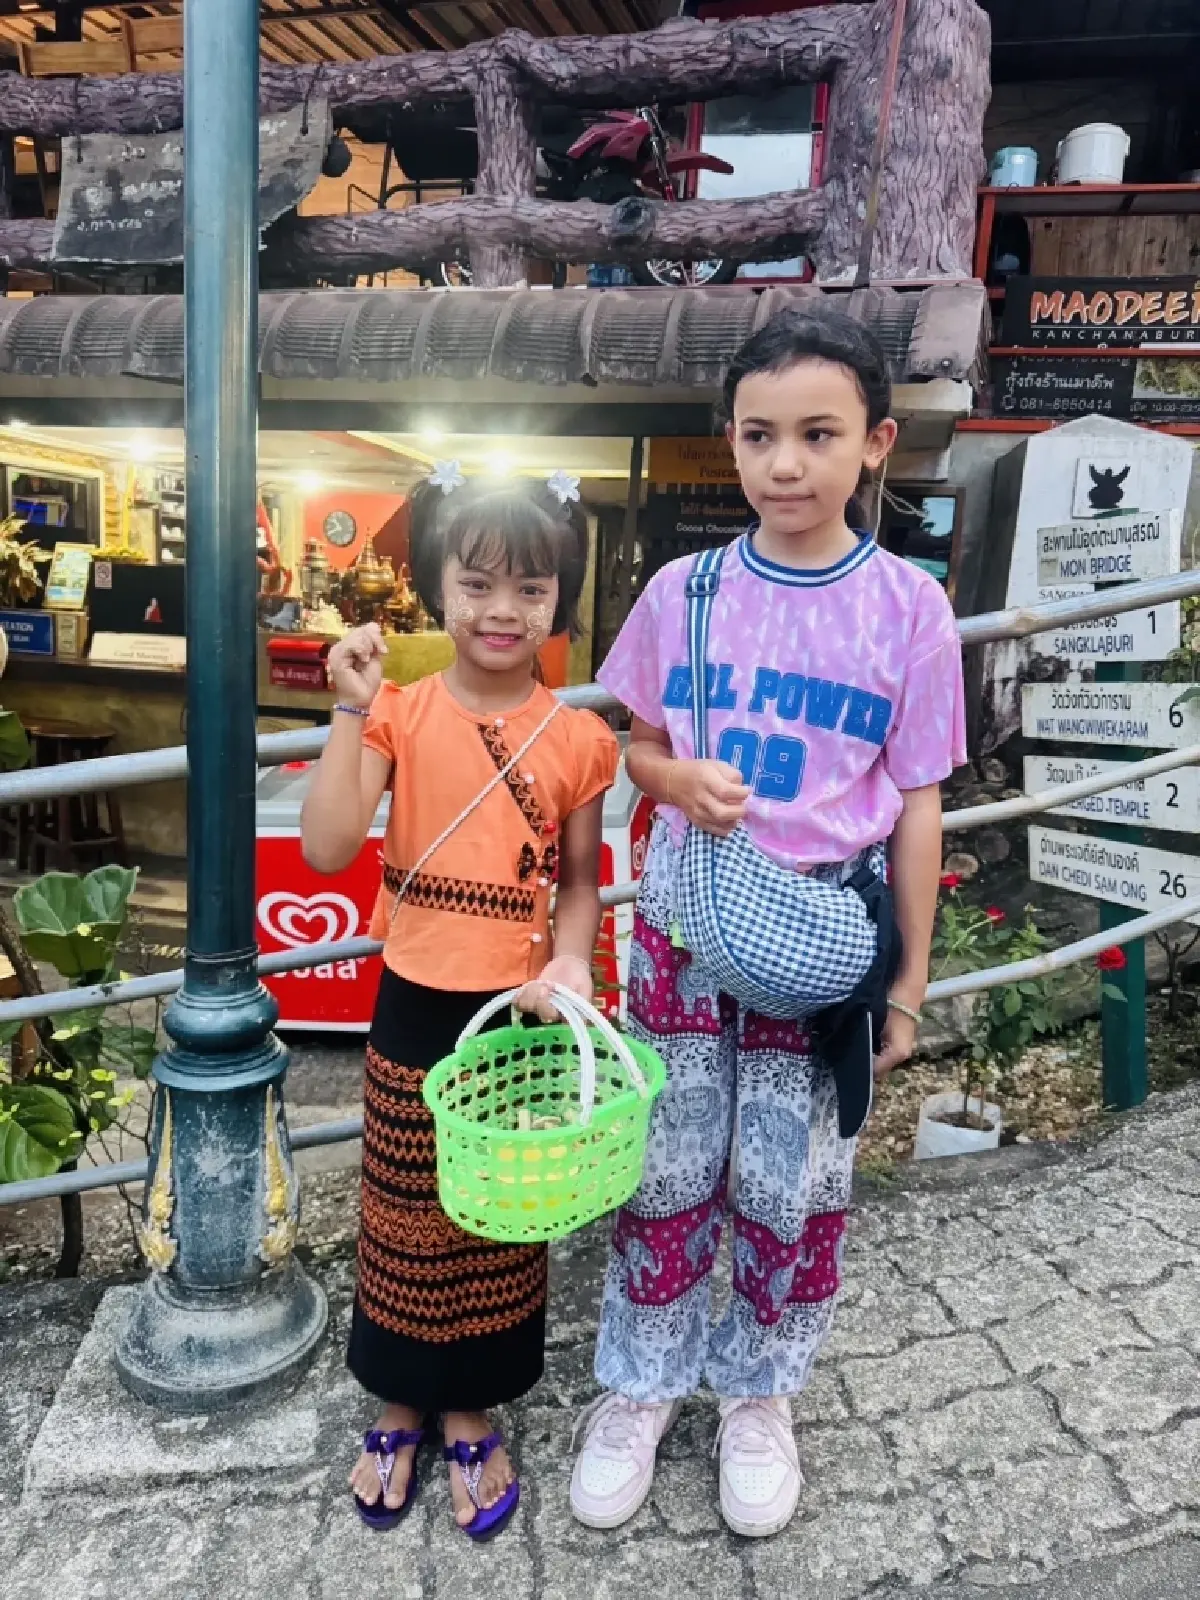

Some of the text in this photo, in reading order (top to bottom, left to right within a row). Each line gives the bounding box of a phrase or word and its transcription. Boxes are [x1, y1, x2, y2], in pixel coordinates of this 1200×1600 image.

[1060, 554, 1132, 578] MON BRIDGE
[1147, 610, 1156, 635] 1
[1054, 633, 1134, 654] SANGKLABURI
[662, 664, 893, 746] GL POWER
[1168, 702, 1184, 728] 6
[1036, 718, 1055, 734] WAT
[716, 727, 808, 802] 09
[1166, 782, 1180, 808] 2
[1108, 797, 1151, 820] TEMPLE
[1038, 860, 1147, 903] DAN CHEDI SAM ONG
[1159, 870, 1187, 899] 26
